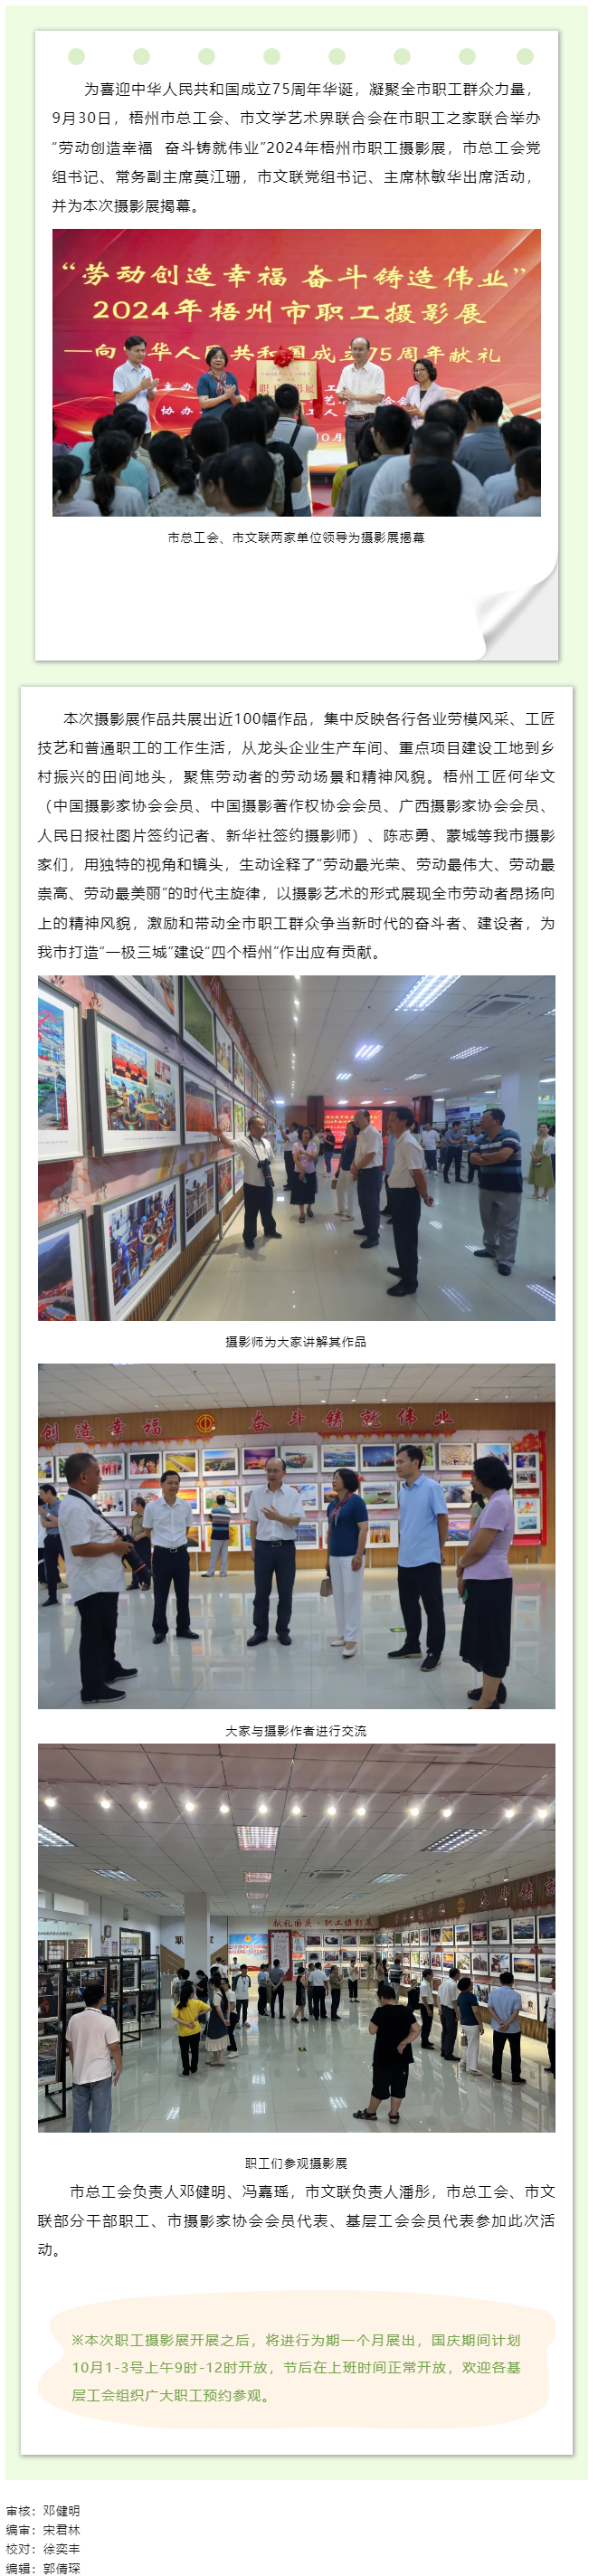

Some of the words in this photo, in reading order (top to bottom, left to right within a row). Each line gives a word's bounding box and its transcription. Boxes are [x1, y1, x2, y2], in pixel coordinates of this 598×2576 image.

[85, 81, 531, 97] 为喜迎中华人民共和国成立75周年华诞，凝聚全市职工群众力量，
[52, 110, 541, 126] 9月30日，梧州市总工会、市文学艺术界联合会在市职工之家联合举办
[52, 169, 531, 185] 组书记、常务副主席莫江珊，市文联党组书记、主席林敏华出席活动，
[52, 199, 197, 214] 并为本次摄影展揭幕。
[93, 298, 487, 324] 2024年梧州市职工摄影展
[168, 531, 425, 545] 市总工会、市文联两家单位领导为摄影展揭幕
[63, 712, 555, 727] 本次摄影展作品共展出近100幅作品，集中反映各行各业劳模风采、工匠
[38, 740, 555, 756] 技艺和普通职工的工作生活，从龙头企业生产车间、重点项目建设工地到乡
[38, 769, 555, 784] 村振兴的田间地头，聚焦劳动者的劳动场景和精神风貌。梧州工匠何华文
[46, 799, 546, 814] （中国摄影家协会会员、中国摄影著作权协会会员、广西摄影家协会会员、
[38, 828, 555, 843] 人民日报社图片签约记者、新华社签约摄影师）、陈志勇、蒙城等我市摄影
[38, 916, 555, 931] 上的精神风貌，激励和带动全市职工群众争当新时代的奋斗者、建设者，为
[225, 1336, 366, 1348] 摄影师为大家讲解其作品
[41, 1418, 162, 1442] 创造幸福
[249, 1406, 454, 1432] 奋斗铸就伟业
[225, 1725, 367, 1737] 大家与摄影作者进行交流
[245, 2157, 348, 2170] 职工们参观摄影展
[70, 2183, 555, 2200] 市总工会负责人邓健明、冯嘉瑶，市文联负责人潘彤，市总工会、市文
[37, 2213, 555, 2229] 联部分干部职工、市摄影家协会会员代表、基层工会会员代表参加此次活
[37, 2242, 60, 2258] 动。
[71, 2389, 271, 2403] 层工会组织广大职工预约参观。
[5, 2505, 81, 2517] 审核：邓健明
[5, 2524, 81, 2536] 编审：宋君林
[5, 2543, 81, 2555] 校对：徐奕丰
